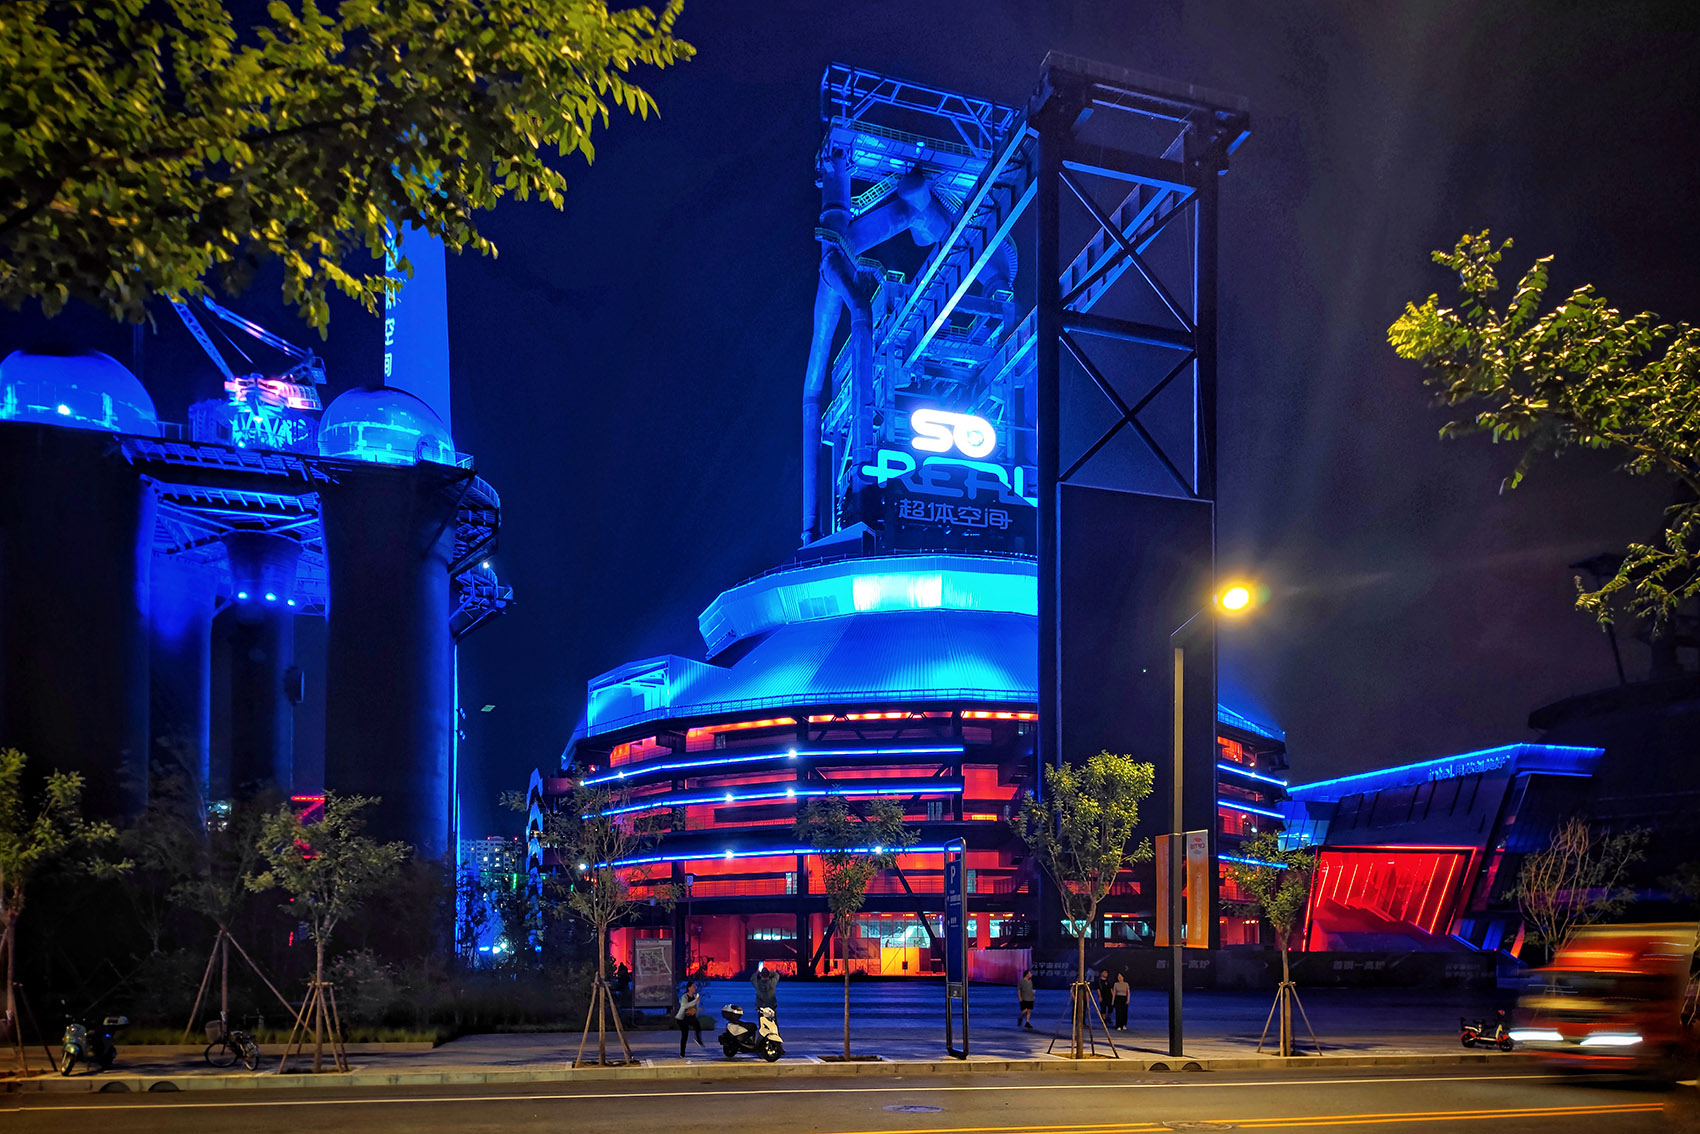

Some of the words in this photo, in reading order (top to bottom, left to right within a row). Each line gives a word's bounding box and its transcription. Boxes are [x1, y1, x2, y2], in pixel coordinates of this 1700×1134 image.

[862, 449, 1038, 507] REAL
[898, 498, 1013, 530] 超体空间
[950, 865, 956, 884] P
